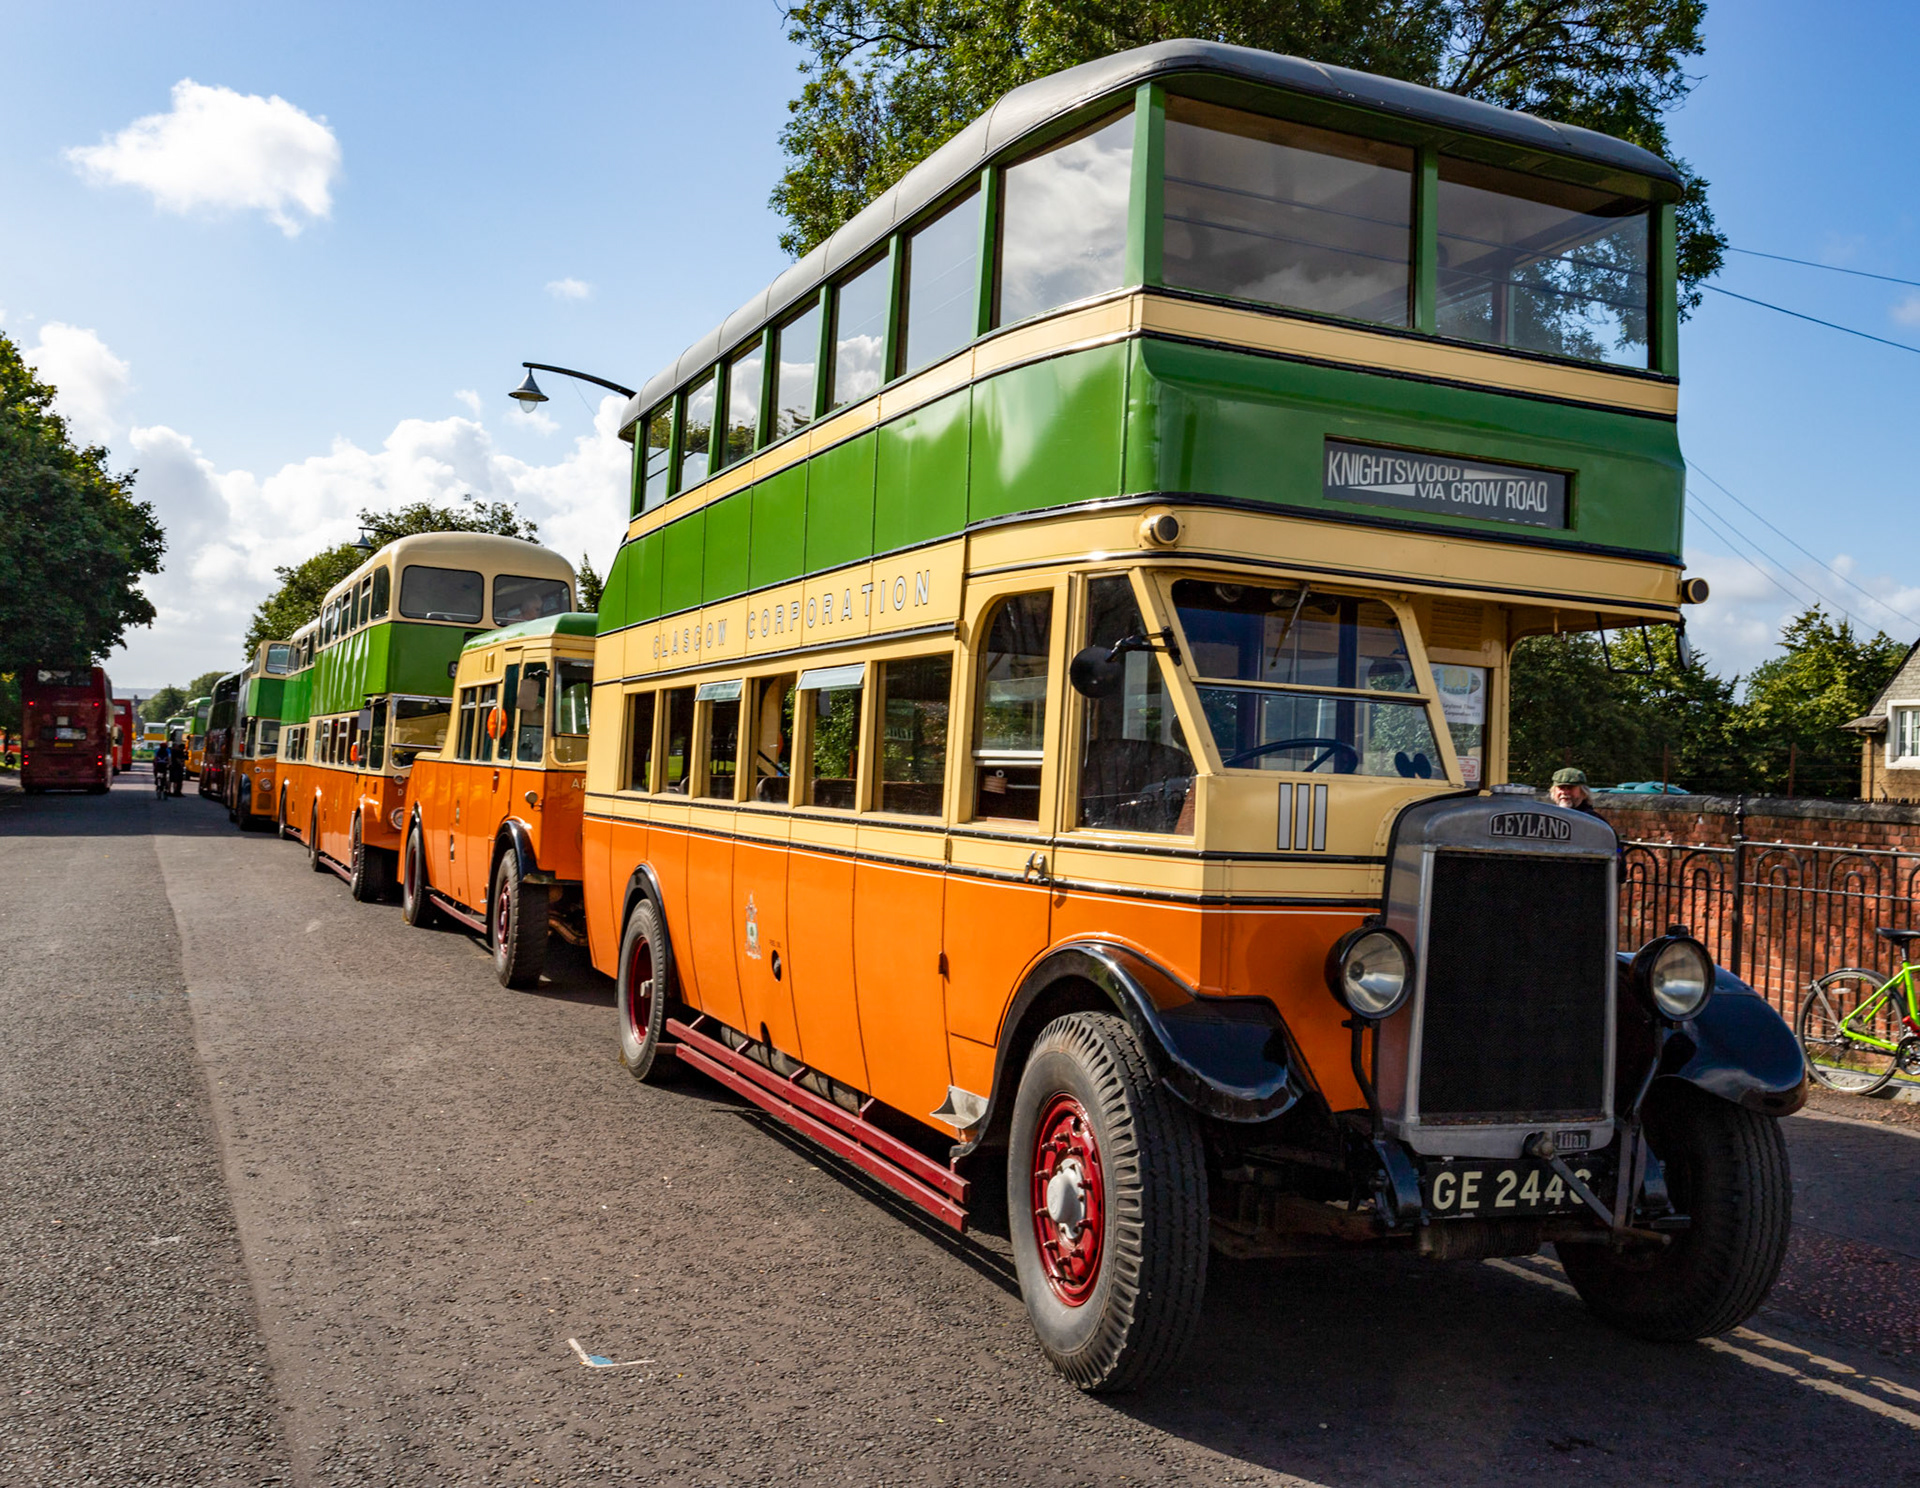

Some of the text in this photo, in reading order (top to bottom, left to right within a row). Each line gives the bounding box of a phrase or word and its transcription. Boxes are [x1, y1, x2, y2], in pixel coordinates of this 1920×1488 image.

[1327, 451, 1461, 486] KNIGHTSWOOD
[1418, 480, 1548, 512] VIA CROW ROAD
[652, 569, 930, 659] GLASGOW CORPORATION
[1492, 814, 1570, 840] LEYLAND
[1558, 1132, 1588, 1149] Titan
[1432, 1171, 1483, 1210] GE
